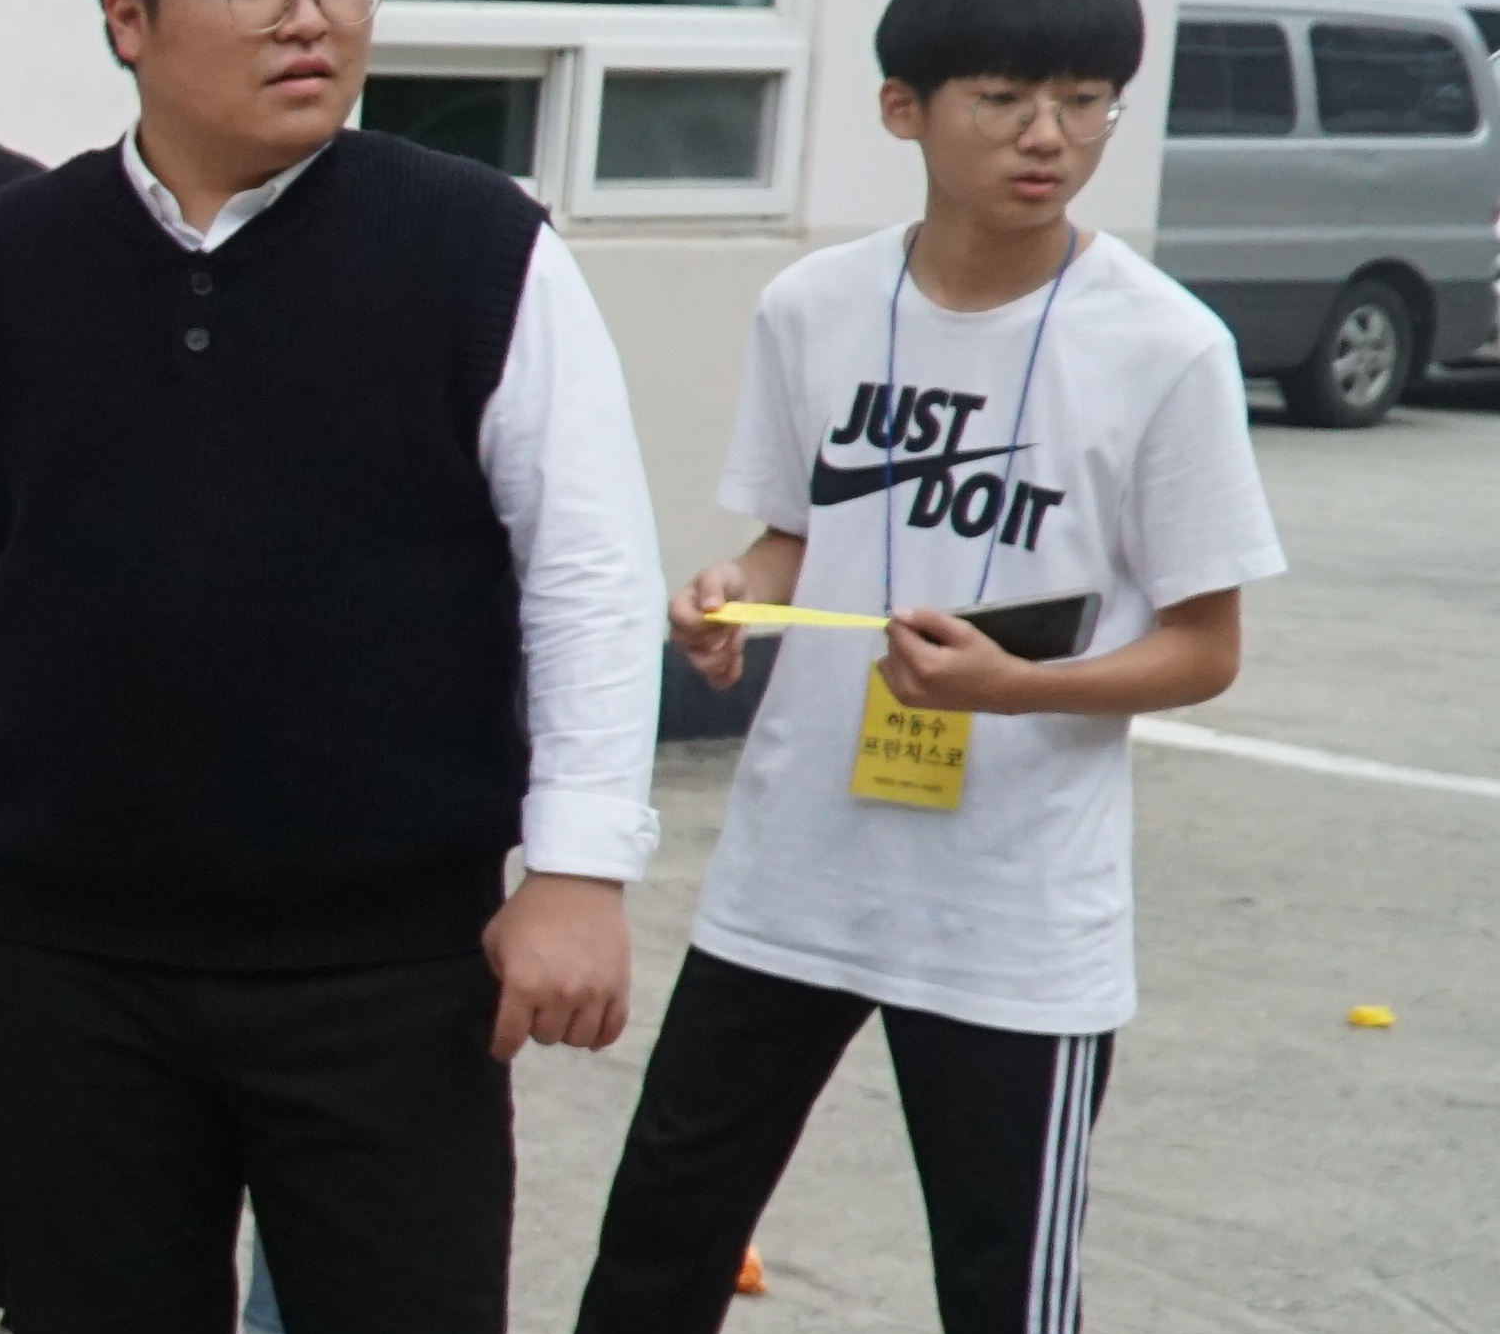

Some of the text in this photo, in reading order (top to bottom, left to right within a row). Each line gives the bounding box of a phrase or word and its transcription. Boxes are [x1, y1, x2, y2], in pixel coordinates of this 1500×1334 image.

[830, 380, 987, 454] JUST
[907, 463, 1067, 553] DO IT
